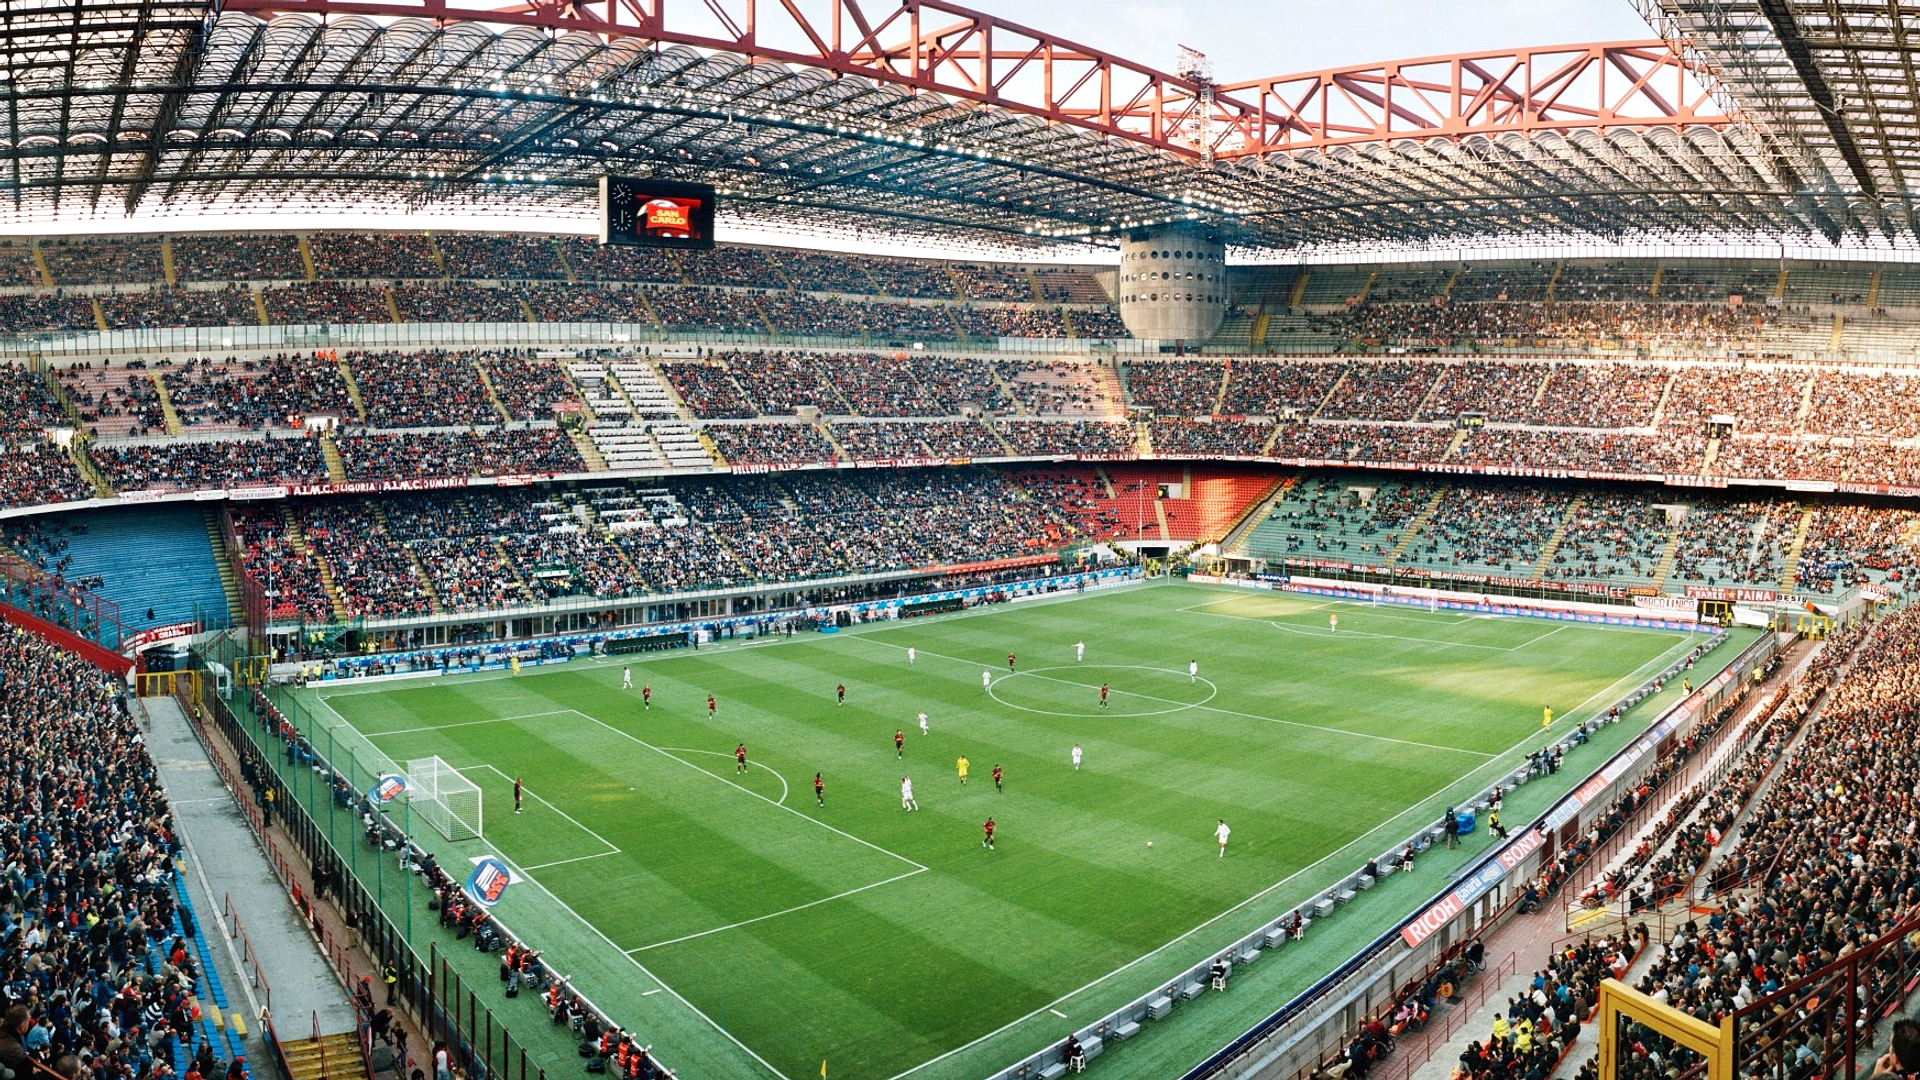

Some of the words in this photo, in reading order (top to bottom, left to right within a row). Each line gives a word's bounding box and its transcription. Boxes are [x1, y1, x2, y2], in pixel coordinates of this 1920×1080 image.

[656, 209, 679, 217] SAN
[650, 216, 686, 224] CARLO
[732, 464, 769, 475] BELLUSCO
[1421, 464, 1473, 474] TORCIDA
[1494, 467, 1568, 478] ROSSONERA
[340, 482, 375, 492] LIGURIA
[429, 478, 464, 488] UMBRIA
[1839, 483, 1877, 494] NAVIGLIO
[1737, 589, 1771, 601] PAINA
[1776, 594, 1807, 603] DESIO
[1637, 597, 1664, 609] MARCO
[1503, 832, 1541, 866] SONY
[1455, 876, 1483, 903] Bavaria
[1408, 897, 1458, 943] RICOH
